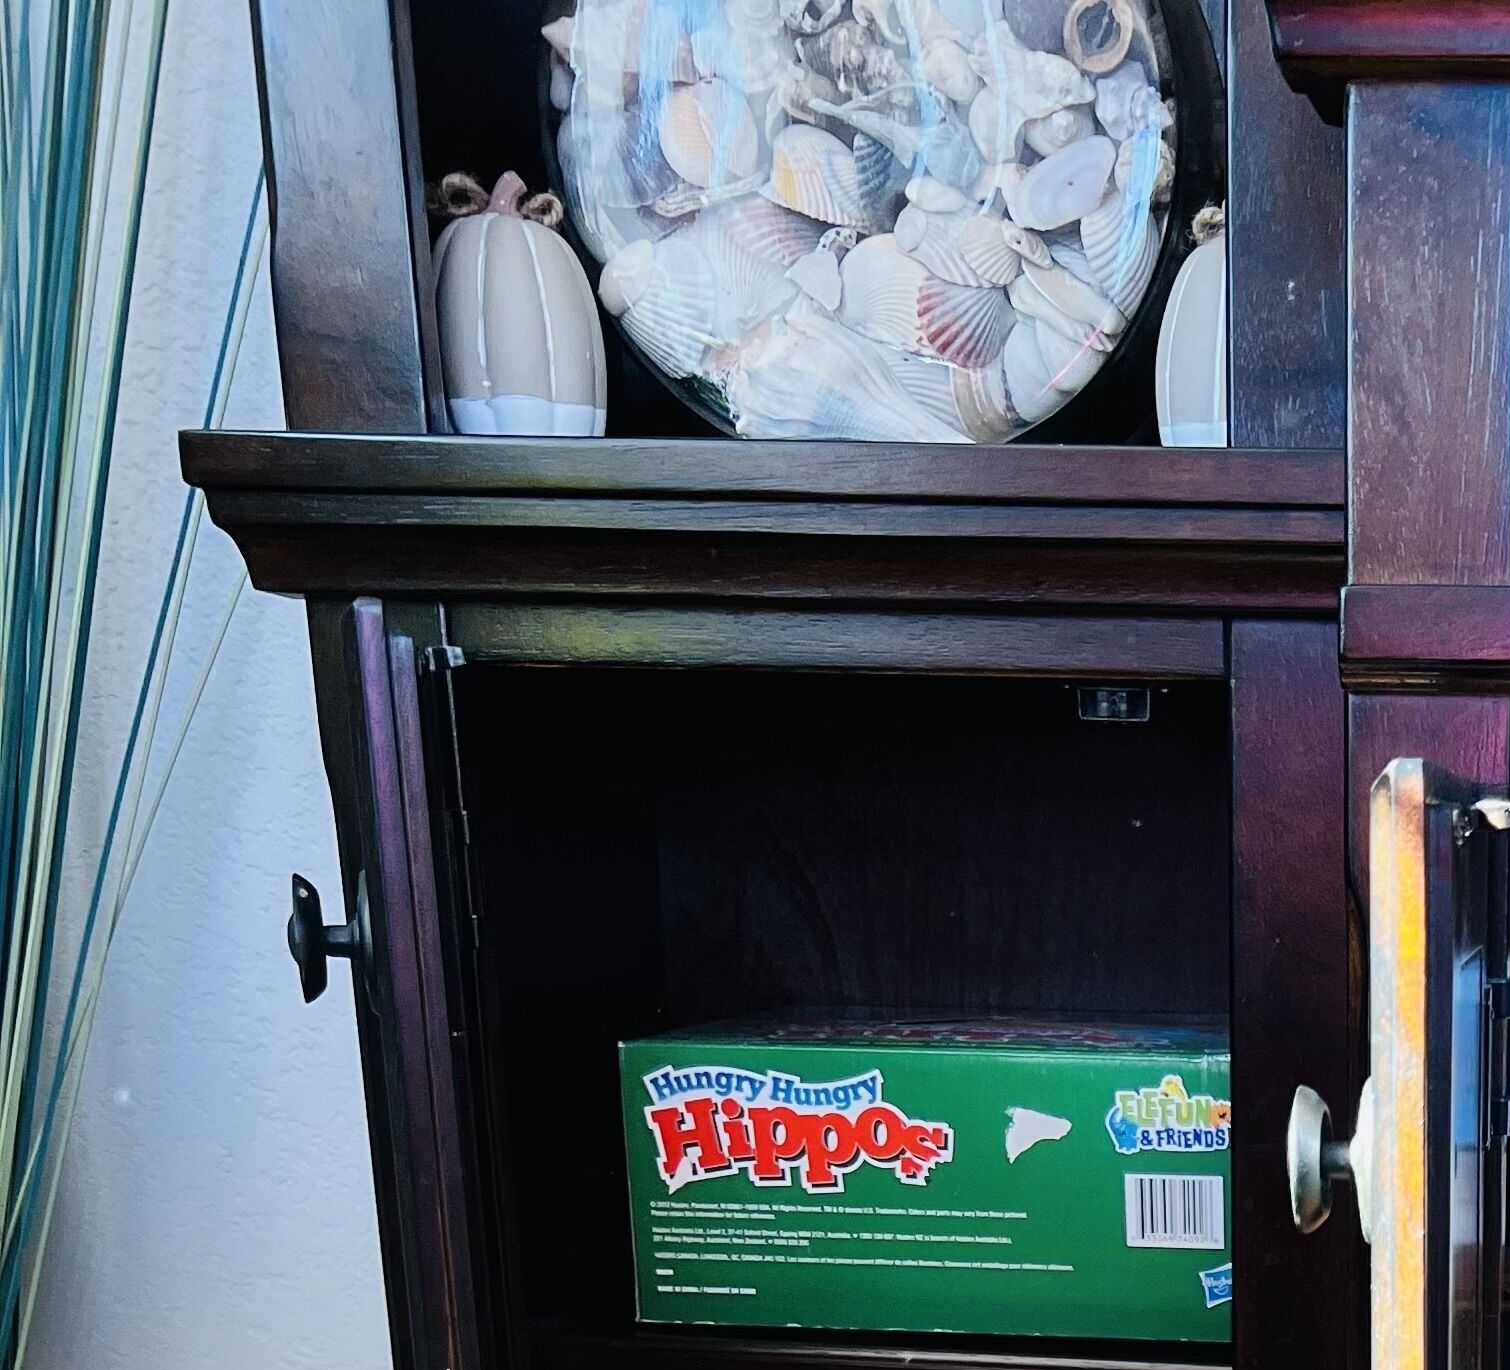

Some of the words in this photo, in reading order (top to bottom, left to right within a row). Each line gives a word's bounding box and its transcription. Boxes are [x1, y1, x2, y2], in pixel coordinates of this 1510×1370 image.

[650, 1070, 767, 1101] Hungry
[770, 1073, 878, 1110] Hungry
[651, 1098, 948, 1186] Hippos
[1140, 1130, 1153, 1147] &
